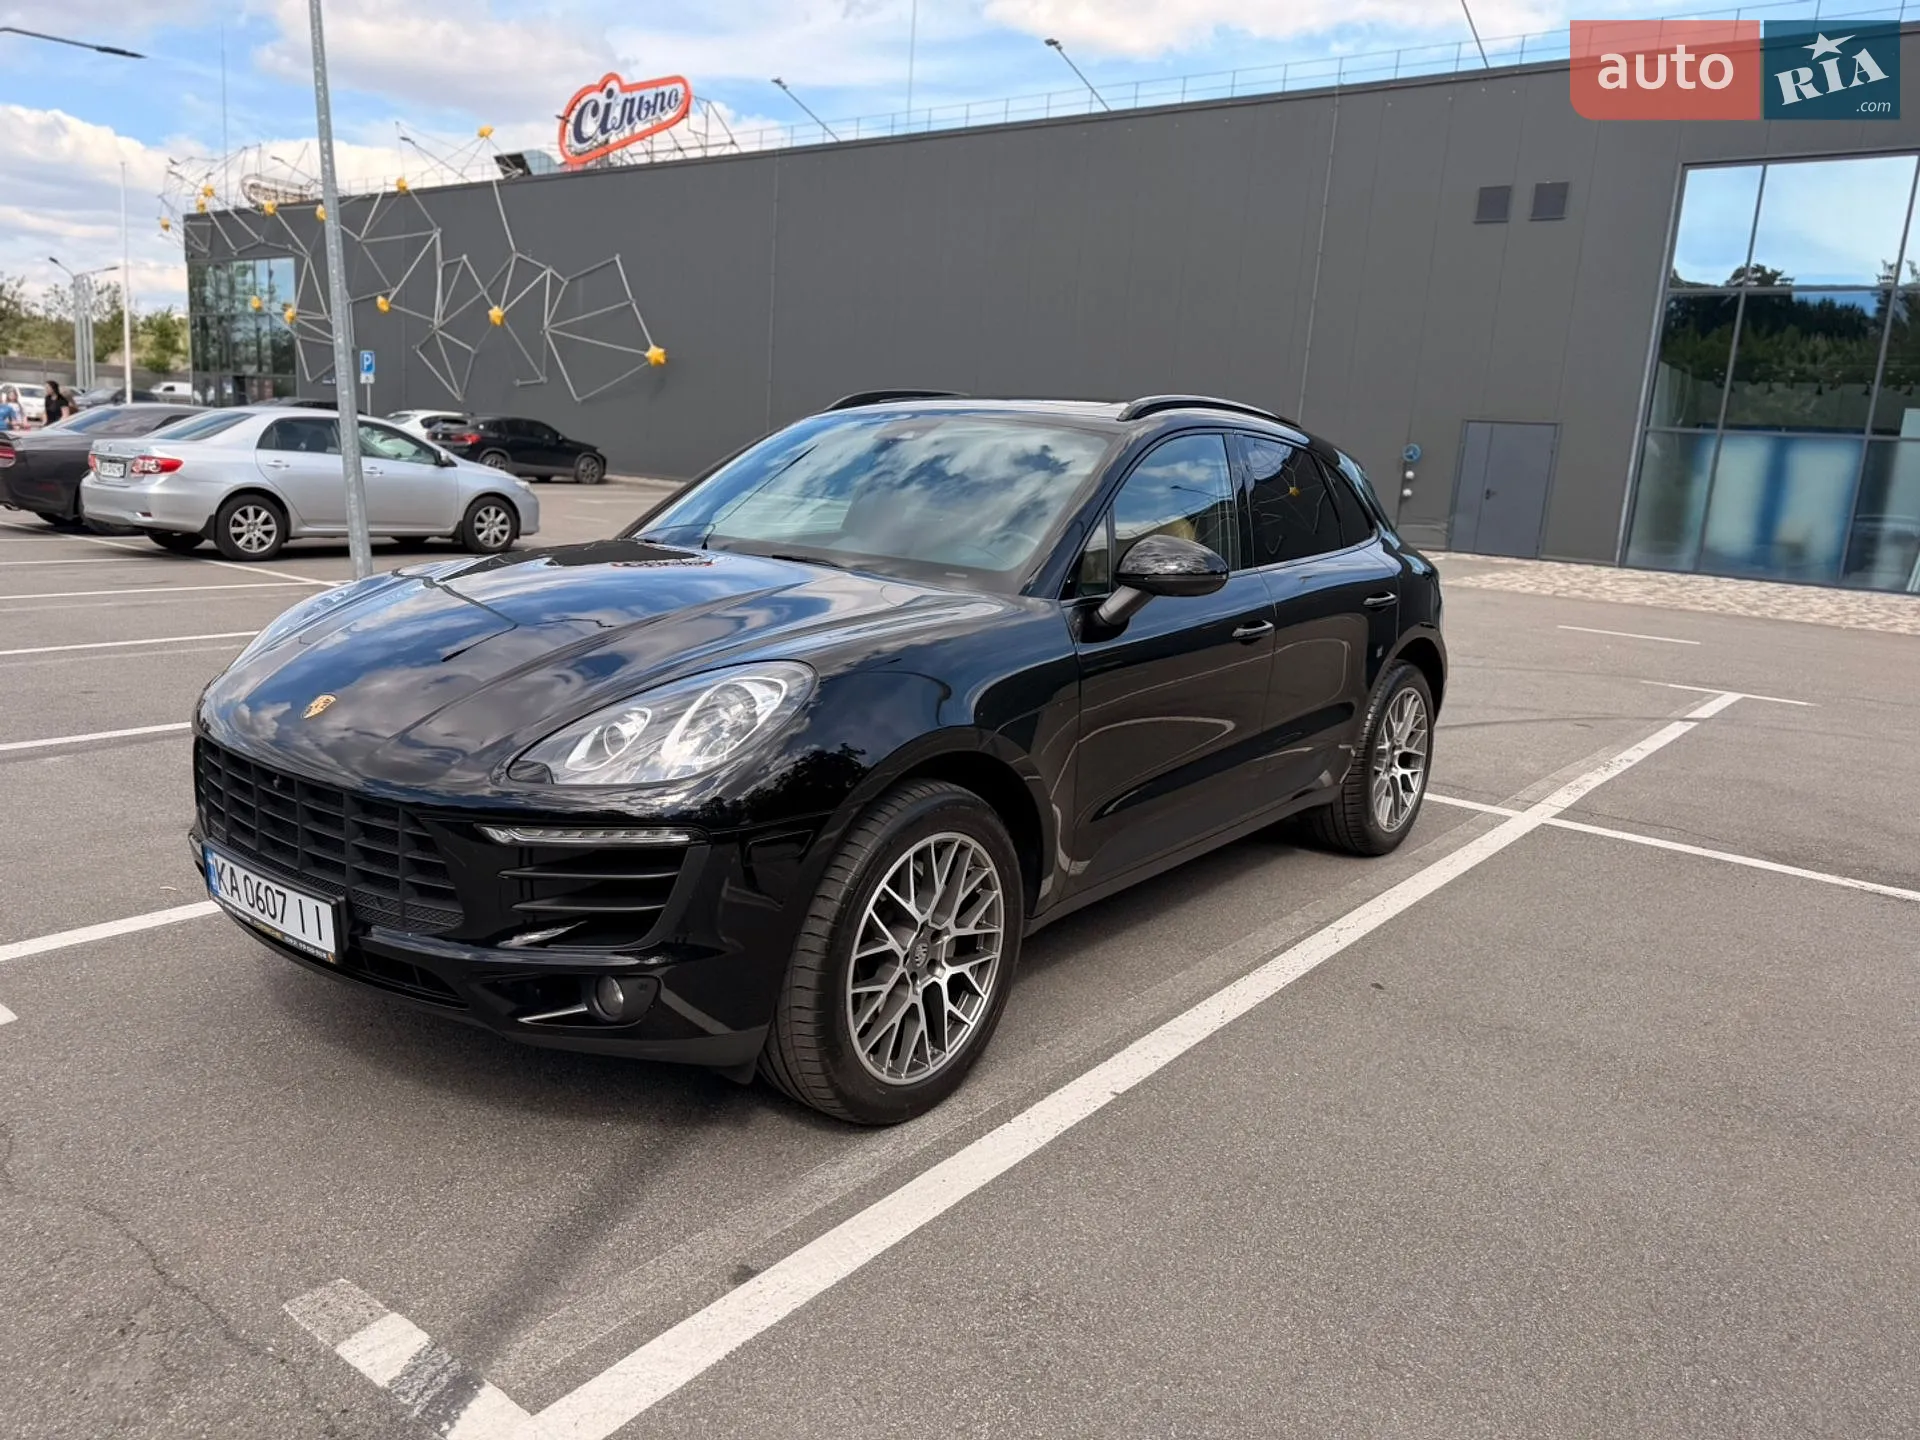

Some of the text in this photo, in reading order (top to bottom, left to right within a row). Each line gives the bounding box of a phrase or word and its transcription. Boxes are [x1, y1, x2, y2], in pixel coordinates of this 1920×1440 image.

[573, 88, 679, 144] Сільпо
[363, 354, 372, 371] P
[214, 858, 242, 902] KA
[243, 874, 286, 924] 0607
